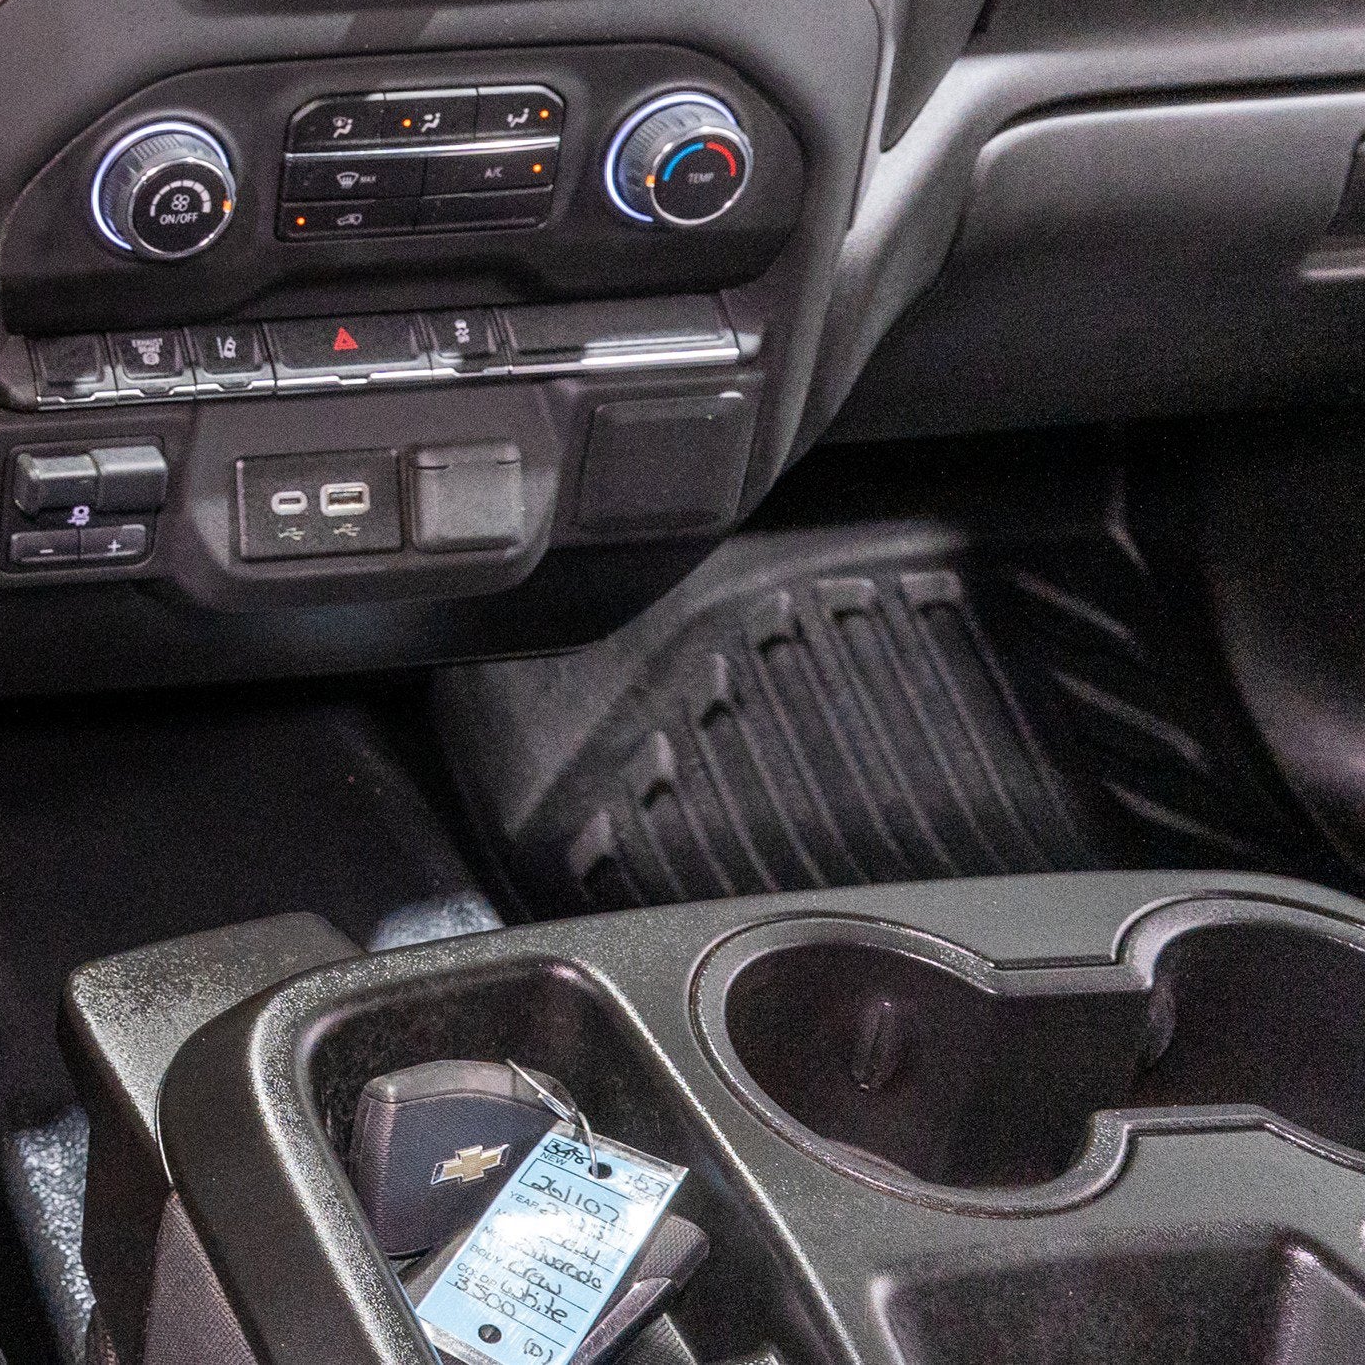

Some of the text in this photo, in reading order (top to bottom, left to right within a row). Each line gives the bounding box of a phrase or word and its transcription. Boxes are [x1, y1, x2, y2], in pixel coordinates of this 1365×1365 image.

[484, 167, 503, 179] A/C
[159, 212, 199, 225] ON/OFF
[539, 1152, 567, 1166] NEW
[509, 1191, 539, 1211] YEAR
